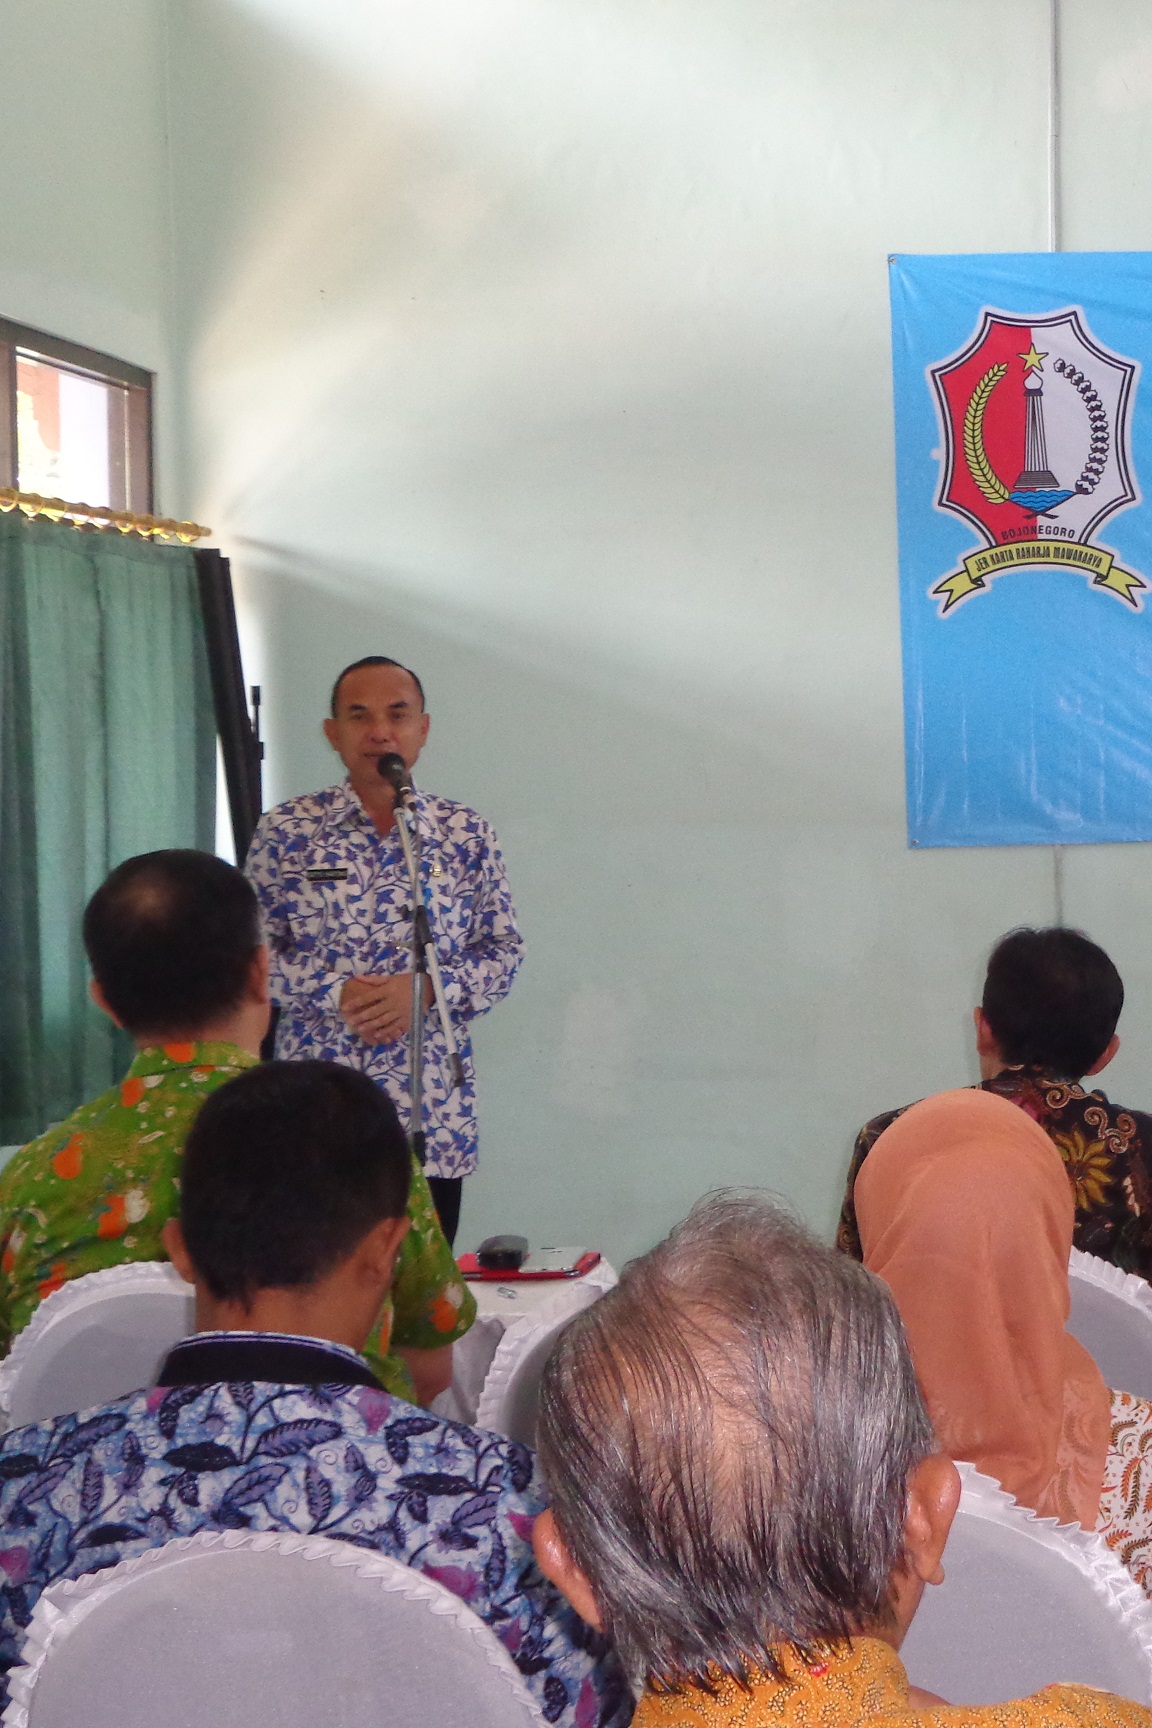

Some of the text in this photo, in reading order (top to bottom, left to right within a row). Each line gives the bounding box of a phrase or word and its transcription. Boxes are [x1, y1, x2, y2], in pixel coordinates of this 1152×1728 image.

[1001, 525, 1076, 540] BOJONEGORO
[975, 556, 989, 572] JER
[989, 549, 1014, 562] KARTA
[1015, 546, 1051, 560] RAHARJA
